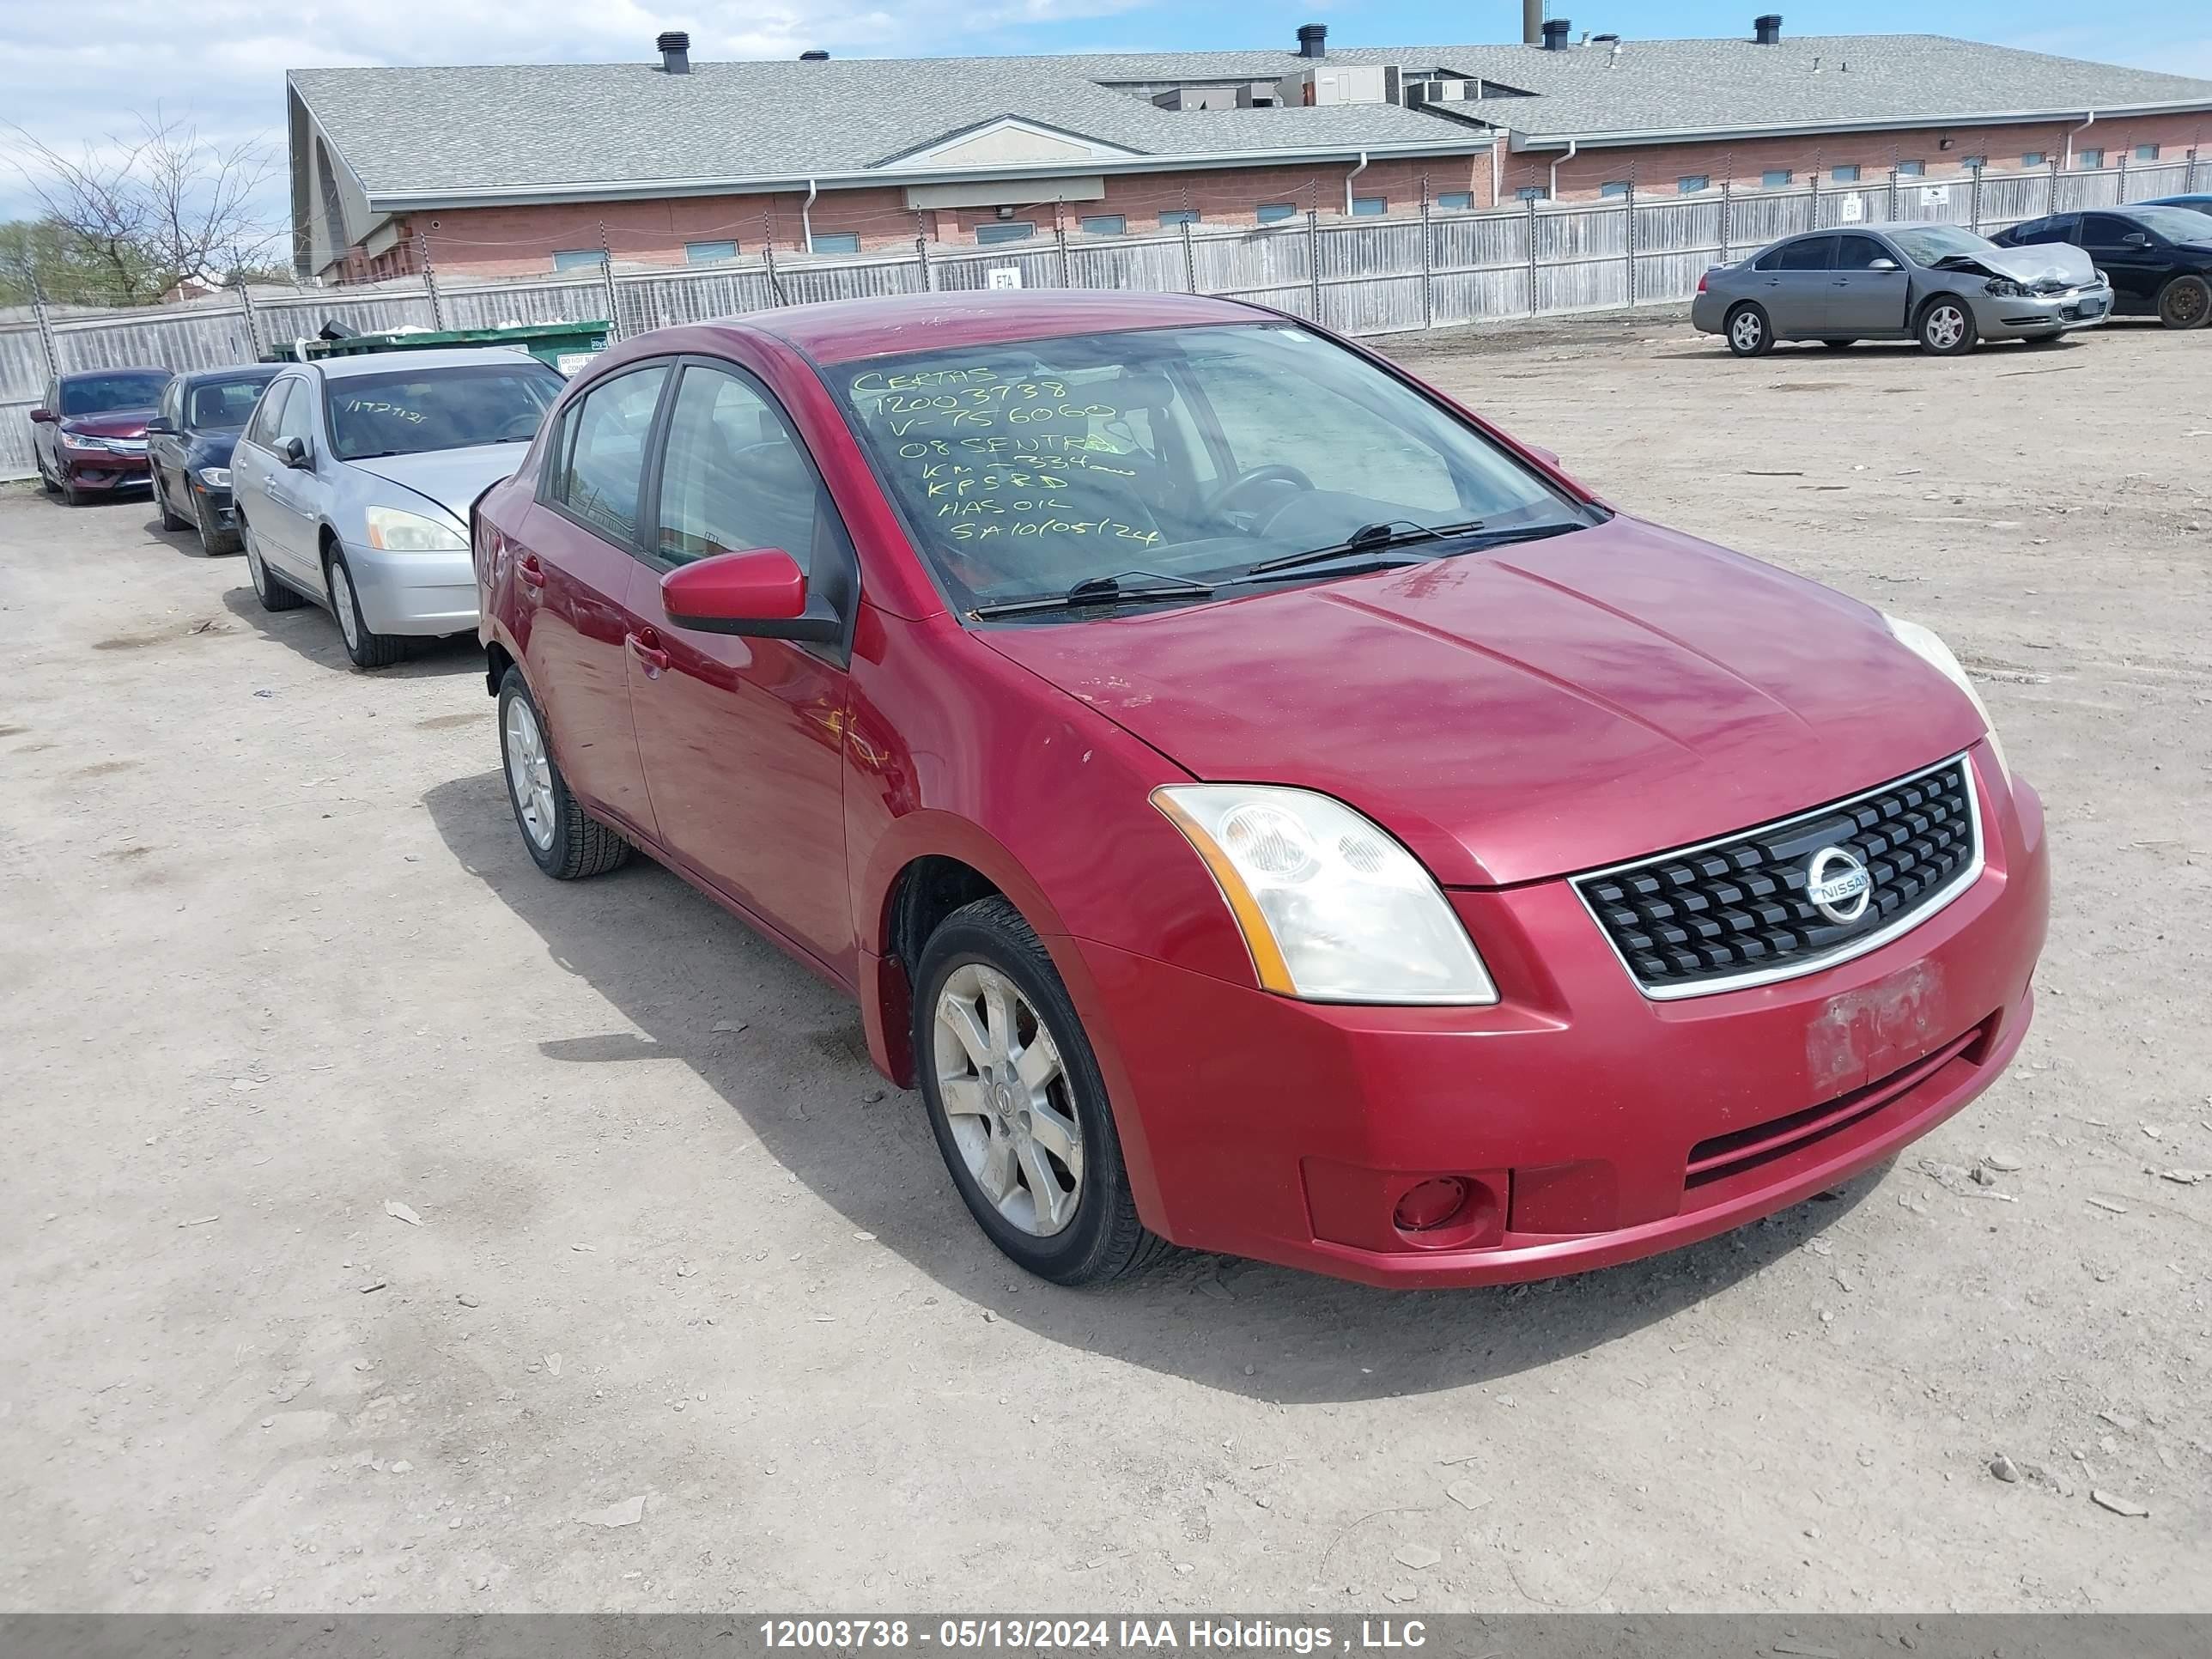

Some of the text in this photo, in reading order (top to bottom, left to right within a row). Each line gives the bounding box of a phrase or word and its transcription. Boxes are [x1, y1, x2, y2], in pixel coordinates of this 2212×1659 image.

[996, 275, 1013, 289] ETA
[854, 368, 999, 392] CERTAS
[875, 380, 1067, 416] 12003738
[899, 440, 951, 459] 08
[937, 498, 1006, 517] HAS
[1821, 874, 1869, 899] NISSAN
